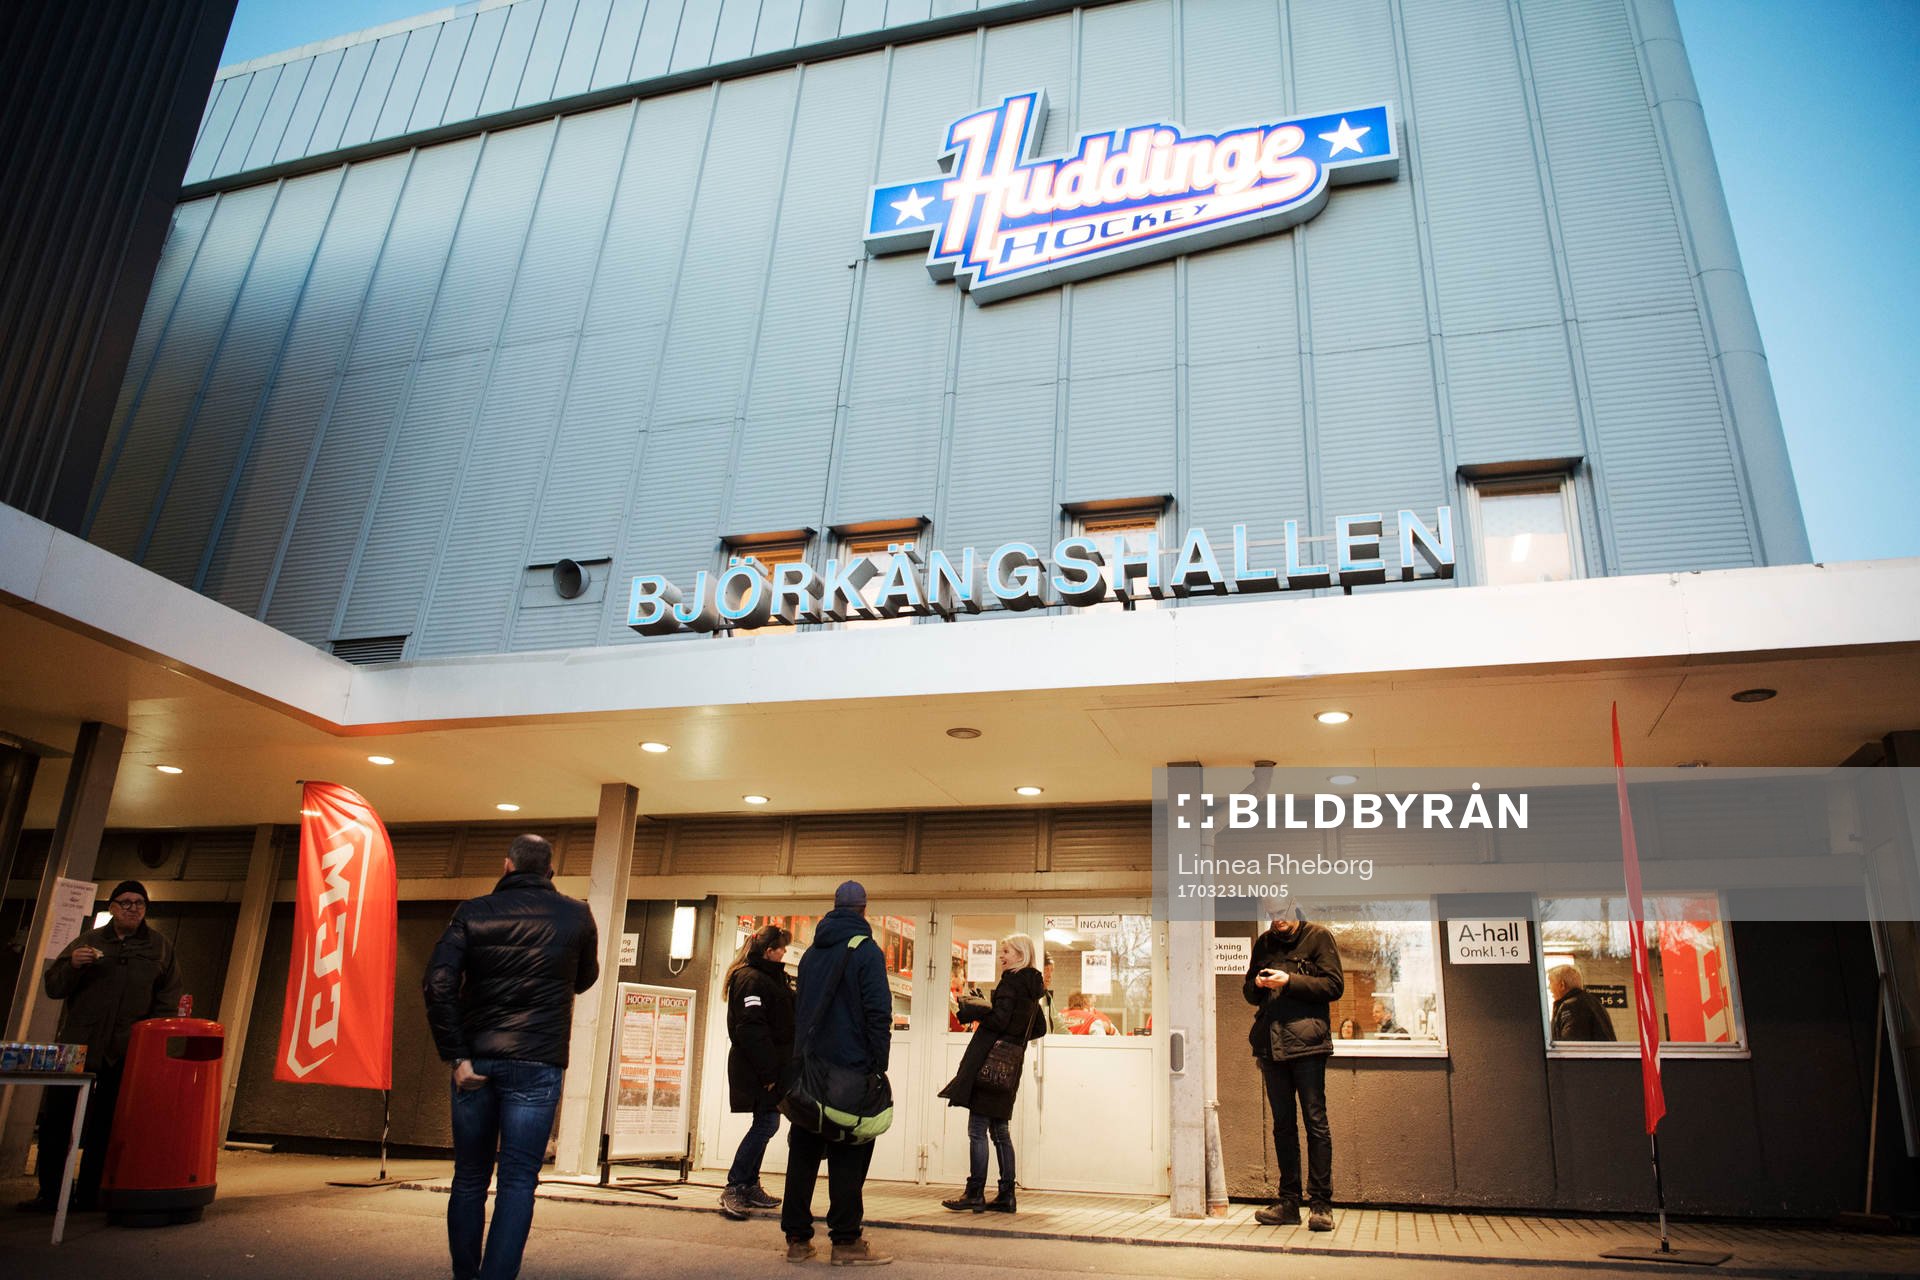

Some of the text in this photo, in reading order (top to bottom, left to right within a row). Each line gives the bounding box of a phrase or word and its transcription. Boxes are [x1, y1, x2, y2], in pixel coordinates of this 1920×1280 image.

[941, 97, 1317, 264] Huddinge
[1000, 203, 1209, 264] HOCKEY
[627, 506, 1454, 632] BJÖRKÄNGSHALLEN
[1080, 919, 1118, 929] INGÅNG
[1459, 922, 1519, 942] A-hall
[307, 841, 356, 1049] CCM
[1215, 943, 1242, 952] kning
[1460, 946, 1519, 958] Omkl. 1-6
[1216, 953, 1249, 962] rbjuden
[1215, 964, 1246, 972] mrådet
